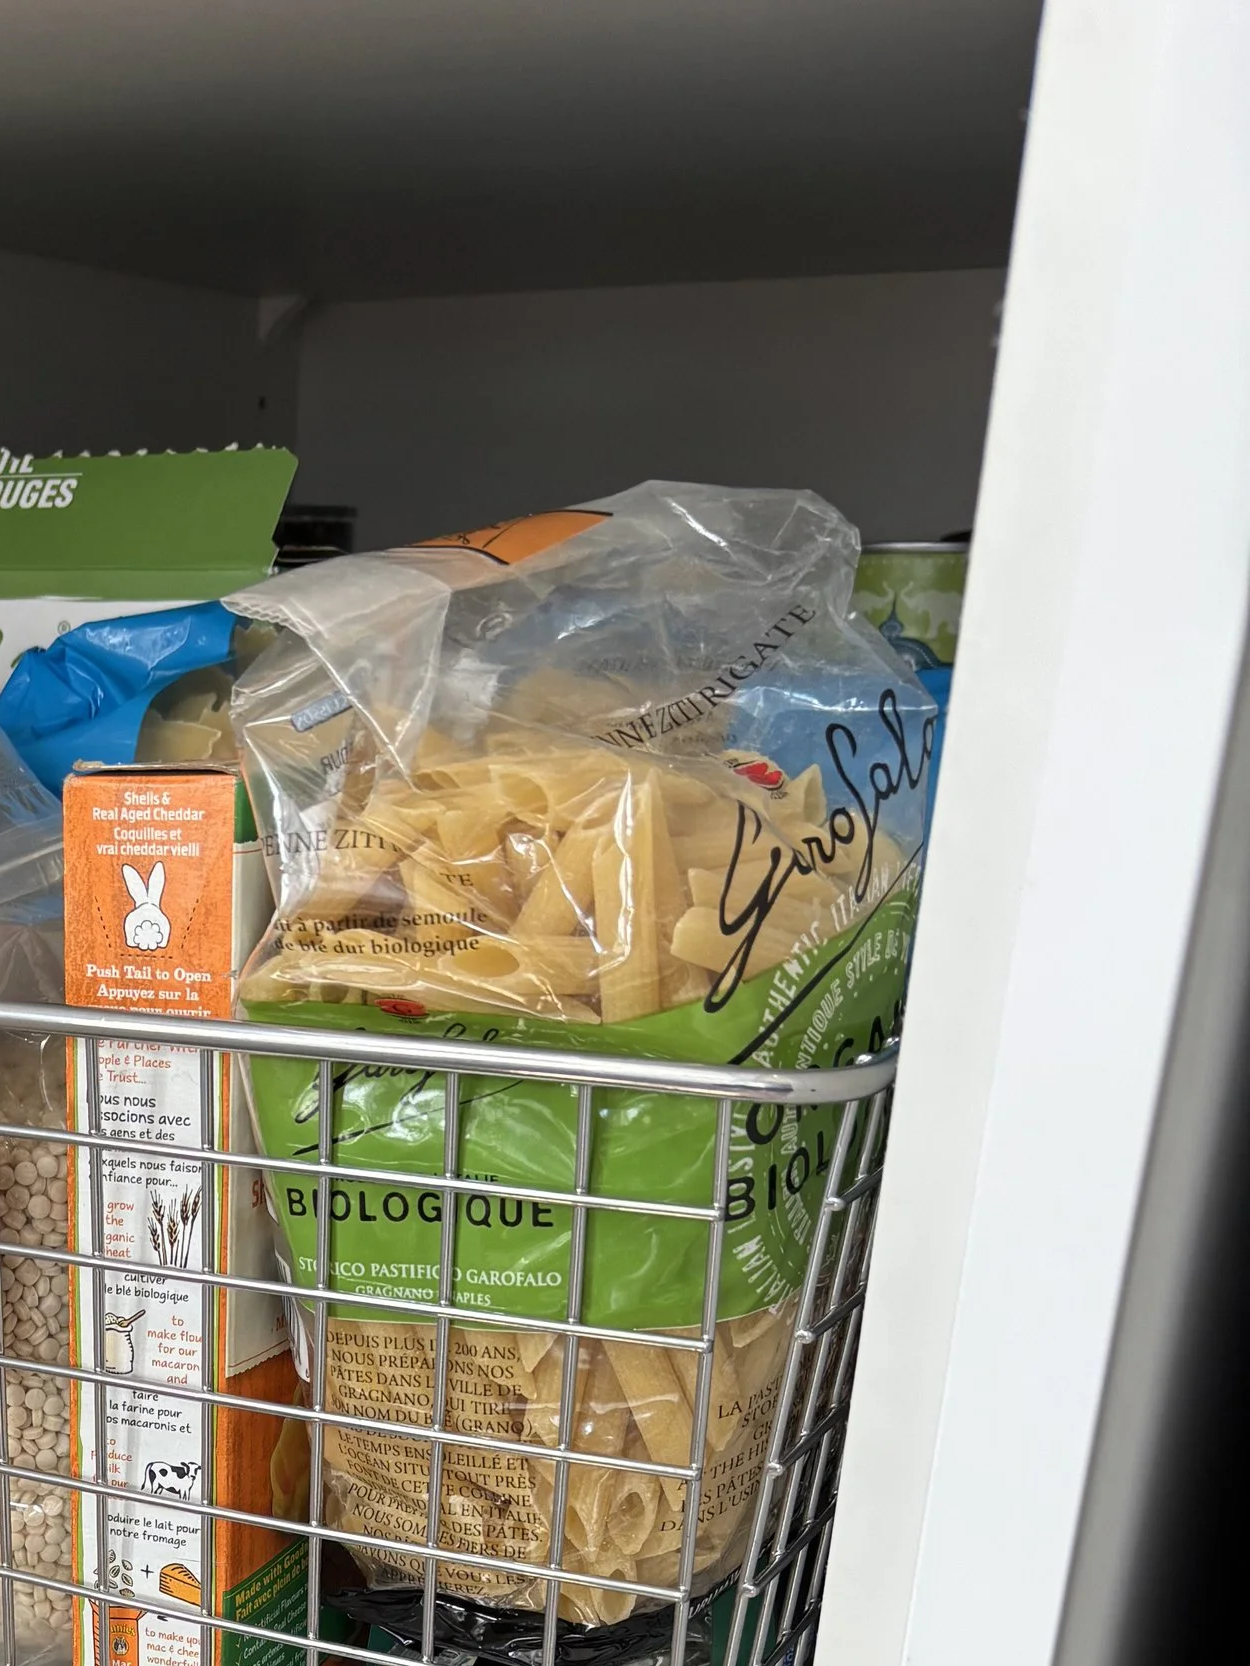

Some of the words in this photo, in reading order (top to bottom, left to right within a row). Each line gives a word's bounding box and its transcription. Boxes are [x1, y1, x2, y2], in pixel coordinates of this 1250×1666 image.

[698, 604, 817, 710] RIGATE
[124, 792, 160, 805] Shells
[162, 792, 170, 804] &
[92, 808, 118, 820] Real
[120, 808, 150, 822] Aged
[153, 808, 205, 820] Cheddar
[114, 827, 168, 842] Coquilles
[170, 828, 182, 840] et
[96, 843, 118, 855] vrai
[120, 843, 170, 856] cheddar
[314, 915, 368, 936] partir
[402, 908, 488, 926] semoule
[332, 940, 364, 954] dur
[370, 936, 480, 958] biologique
[86, 964, 120, 978] Push
[124, 966, 152, 980] Tail
[155, 969, 170, 980] to
[174, 968, 212, 986] Open
[96, 984, 154, 1000] Appuyez
[158, 989, 182, 1000] sur
[186, 986, 199, 1000] la
[134, 1055, 172, 1068] Places
[124, 1096, 156, 1108] nous
[158, 1114, 192, 1126] avec
[155, 1128, 176, 1141] des
[140, 1161, 166, 1172] nous
[108, 1202, 134, 1214] grow
[106, 1214, 124, 1226] the
[466, 1269, 562, 1287] GAROFALO
[116, 1284, 132, 1296] blé
[134, 1288, 189, 1304] biologique
[172, 1316, 184, 1326] to
[147, 1330, 177, 1340] make
[158, 1342, 174, 1354] for
[178, 1348, 198, 1356] our
[384, 1336, 424, 1351] PLUS
[454, 1342, 478, 1358] 200
[482, 1346, 522, 1362] ANS,
[332, 1348, 374, 1366] NOUS
[478, 1365, 514, 1379] NOS
[166, 1374, 188, 1384] and
[330, 1366, 372, 1384] PÂTES
[376, 1372, 421, 1388] DANS
[449, 1378, 493, 1396] VILLE
[498, 1384, 522, 1396] DE
[122, 1400, 154, 1415] farine
[158, 1410, 182, 1420] pour
[354, 1405, 390, 1421] NOM
[396, 1409, 419, 1424] DU
[121, 1417, 176, 1432] macaronis
[179, 1423, 192, 1434] et
[354, 1436, 400, 1456] TEMPS
[496, 1474, 536, 1490] PRÈS
[144, 1517, 152, 1528] le
[155, 1518, 174, 1531] lait
[176, 1524, 201, 1536] pour
[352, 1504, 394, 1527] NOUS
[503, 1545, 527, 1560] DE
[110, 1528, 139, 1539] notre
[142, 1530, 187, 1549] fromage
[236, 1578, 262, 1605] Made
[145, 1627, 156, 1638] to
[158, 1632, 184, 1642] make
[146, 1642, 166, 1652] mac
